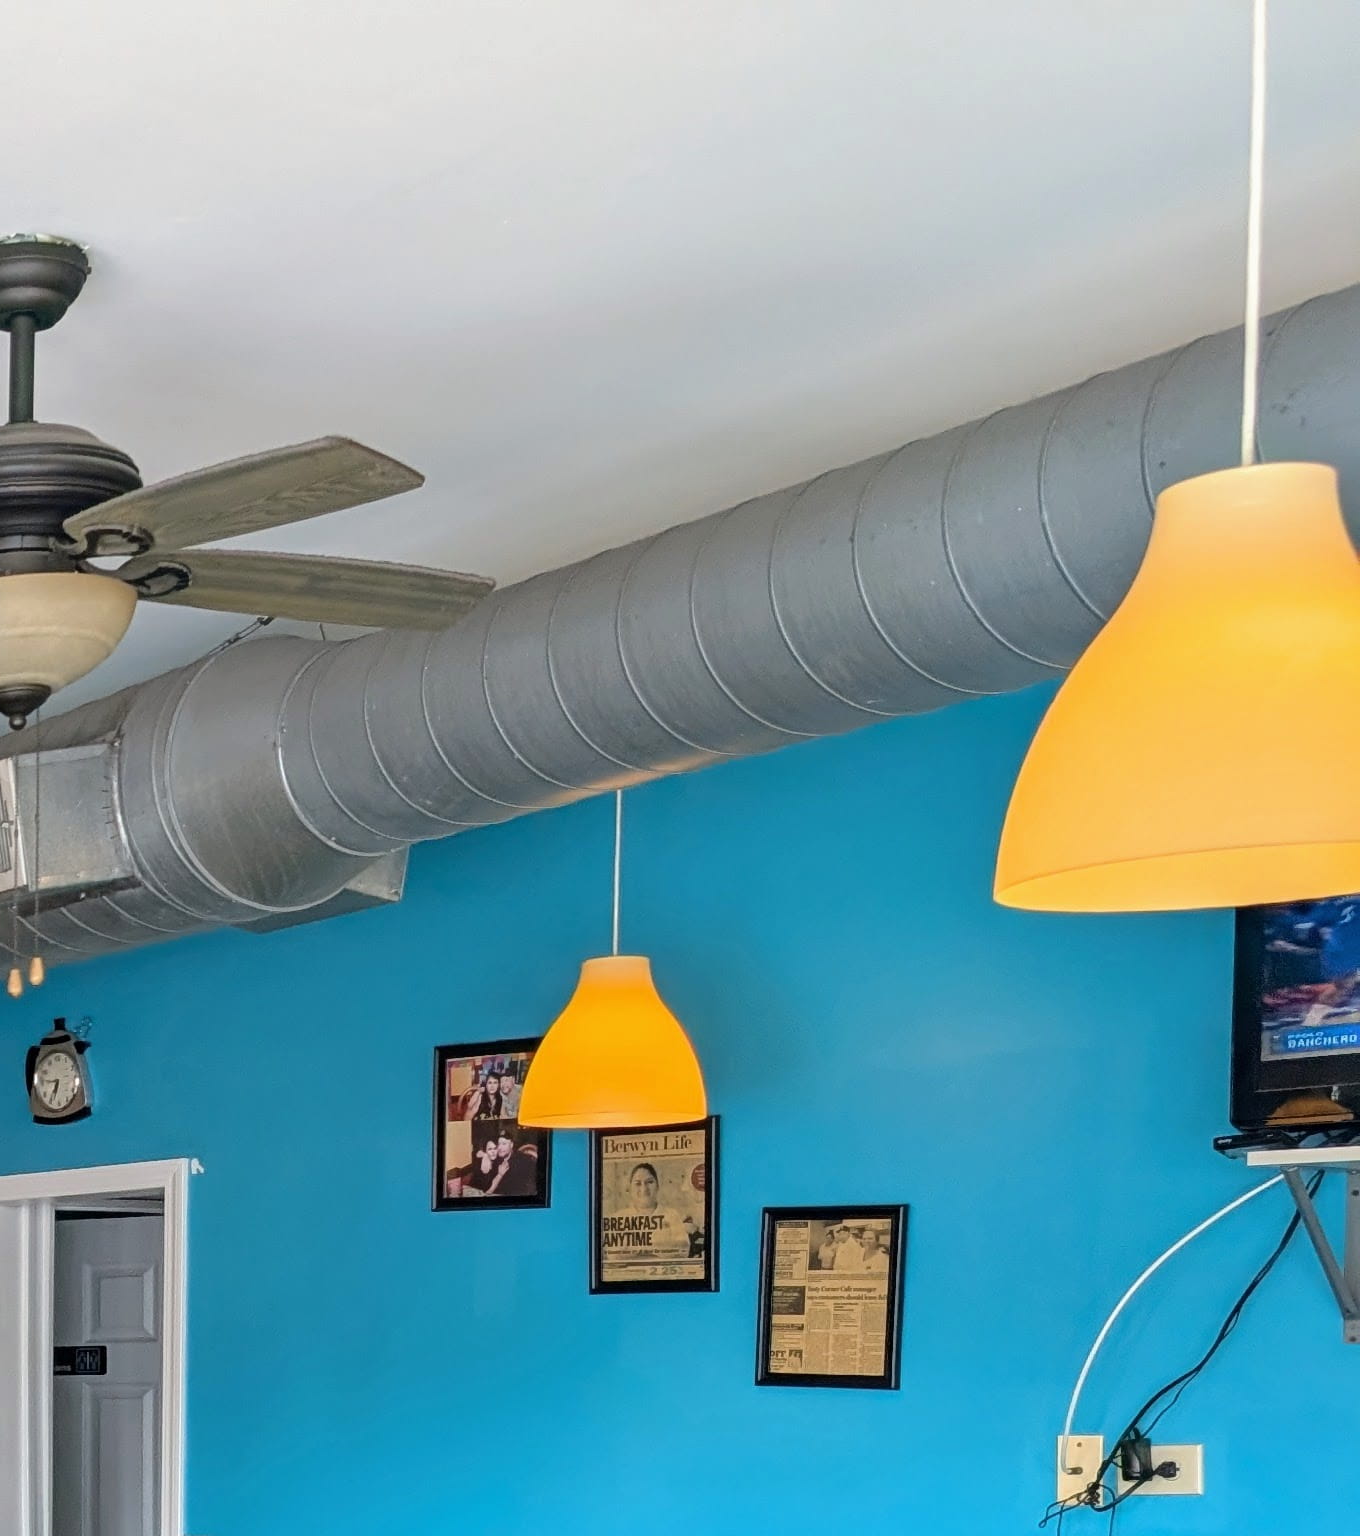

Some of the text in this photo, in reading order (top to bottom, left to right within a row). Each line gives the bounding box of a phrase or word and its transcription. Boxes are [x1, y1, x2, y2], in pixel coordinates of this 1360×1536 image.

[604, 1135, 692, 1155] Berwyn Life
[603, 1215, 665, 1232] BREAKFAST
[603, 1231, 653, 1247] ANYTIME
